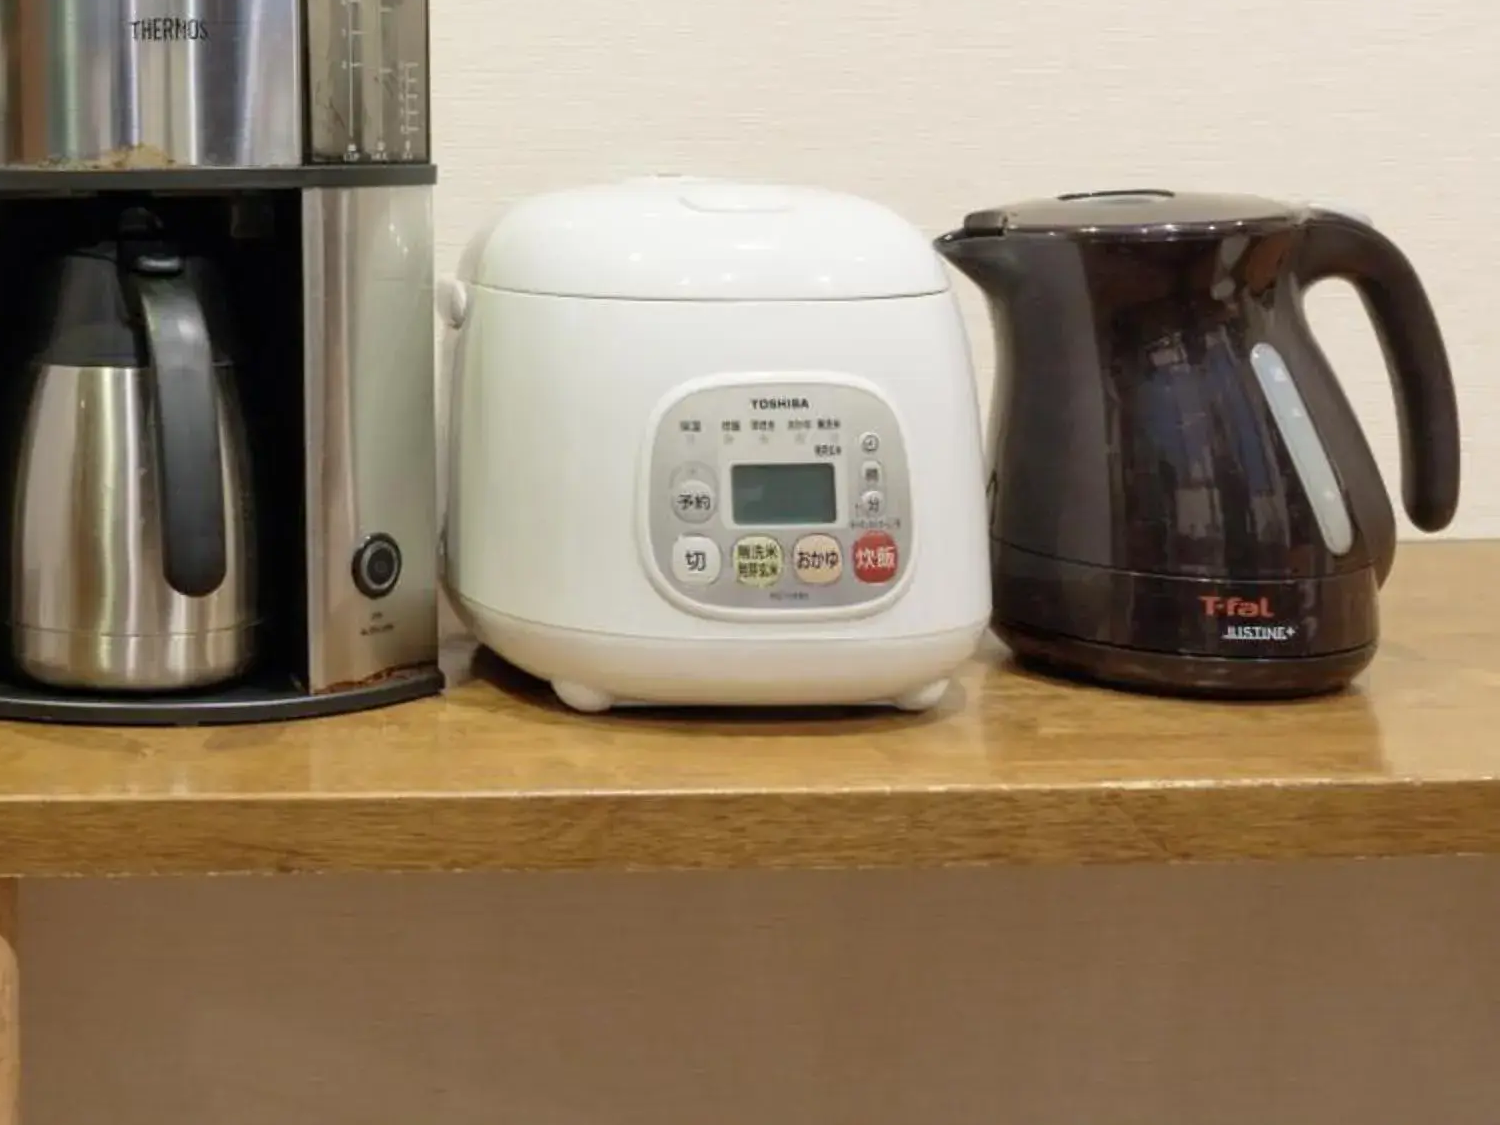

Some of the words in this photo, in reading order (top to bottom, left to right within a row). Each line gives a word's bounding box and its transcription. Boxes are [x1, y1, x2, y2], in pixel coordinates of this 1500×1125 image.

[128, 17, 209, 41] THERMOS
[752, 398, 810, 410] TOSHIBA
[676, 493, 712, 511] 予約
[685, 550, 707, 572] 切
[797, 550, 839, 569] おかゆ
[855, 546, 897, 569] 炊飯
